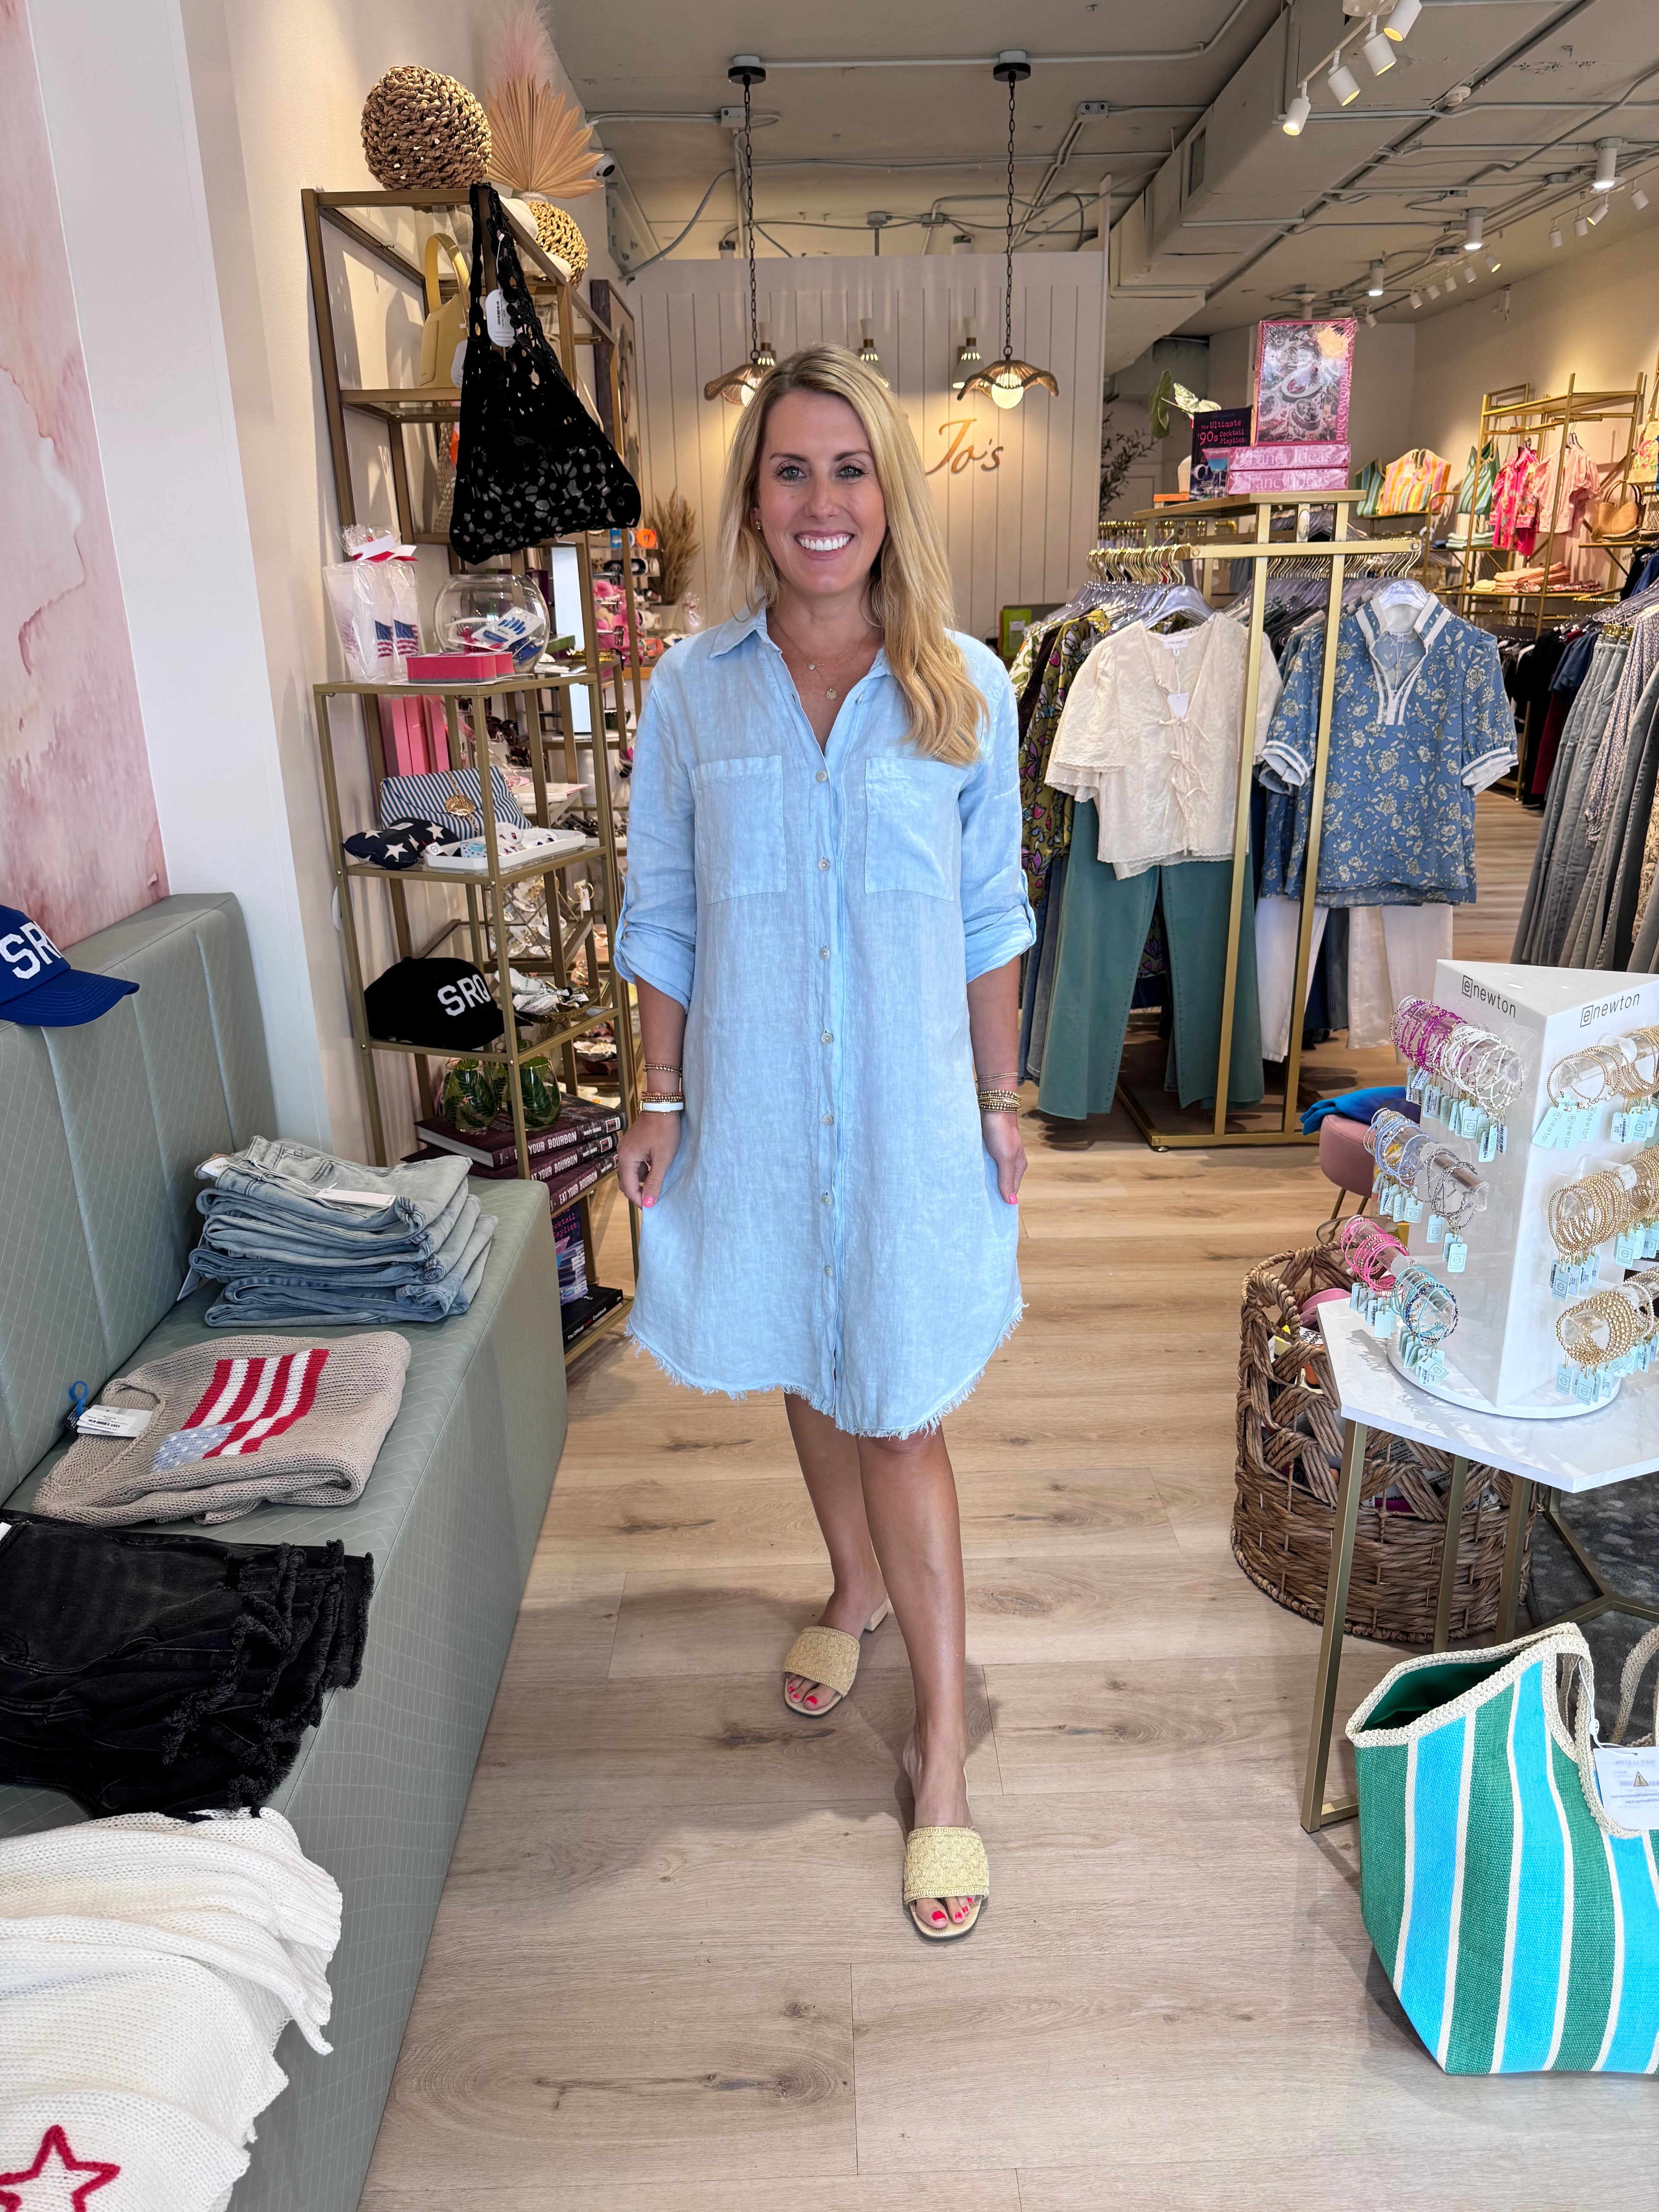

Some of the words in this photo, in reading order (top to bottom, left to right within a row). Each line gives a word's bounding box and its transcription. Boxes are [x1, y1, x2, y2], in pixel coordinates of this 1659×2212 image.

[1210, 420, 1241, 429] Ultimate
[1220, 429, 1244, 437] Cocktail
[925, 418, 1004, 476] Jo's
[1249, 450, 1292, 467] Fancy
[1294, 448, 1331, 464] Ideas
[1291, 472, 1330, 488] Ideas
[0, 921, 64, 979] SR
[437, 974, 491, 1016] SRQ
[528, 1141, 545, 1155] YOUR
[547, 1131, 577, 1149] BOURBON
[538, 1166, 552, 1180] YOUR
[554, 1154, 578, 1173] BOURBON
[559, 1192, 568, 1205] EAT
[567, 1183, 579, 1199] YOUR
[579, 1170, 597, 1191] BOURBON
[553, 1213, 575, 1230] ocktail
[553, 1222, 577, 1238] laylist
